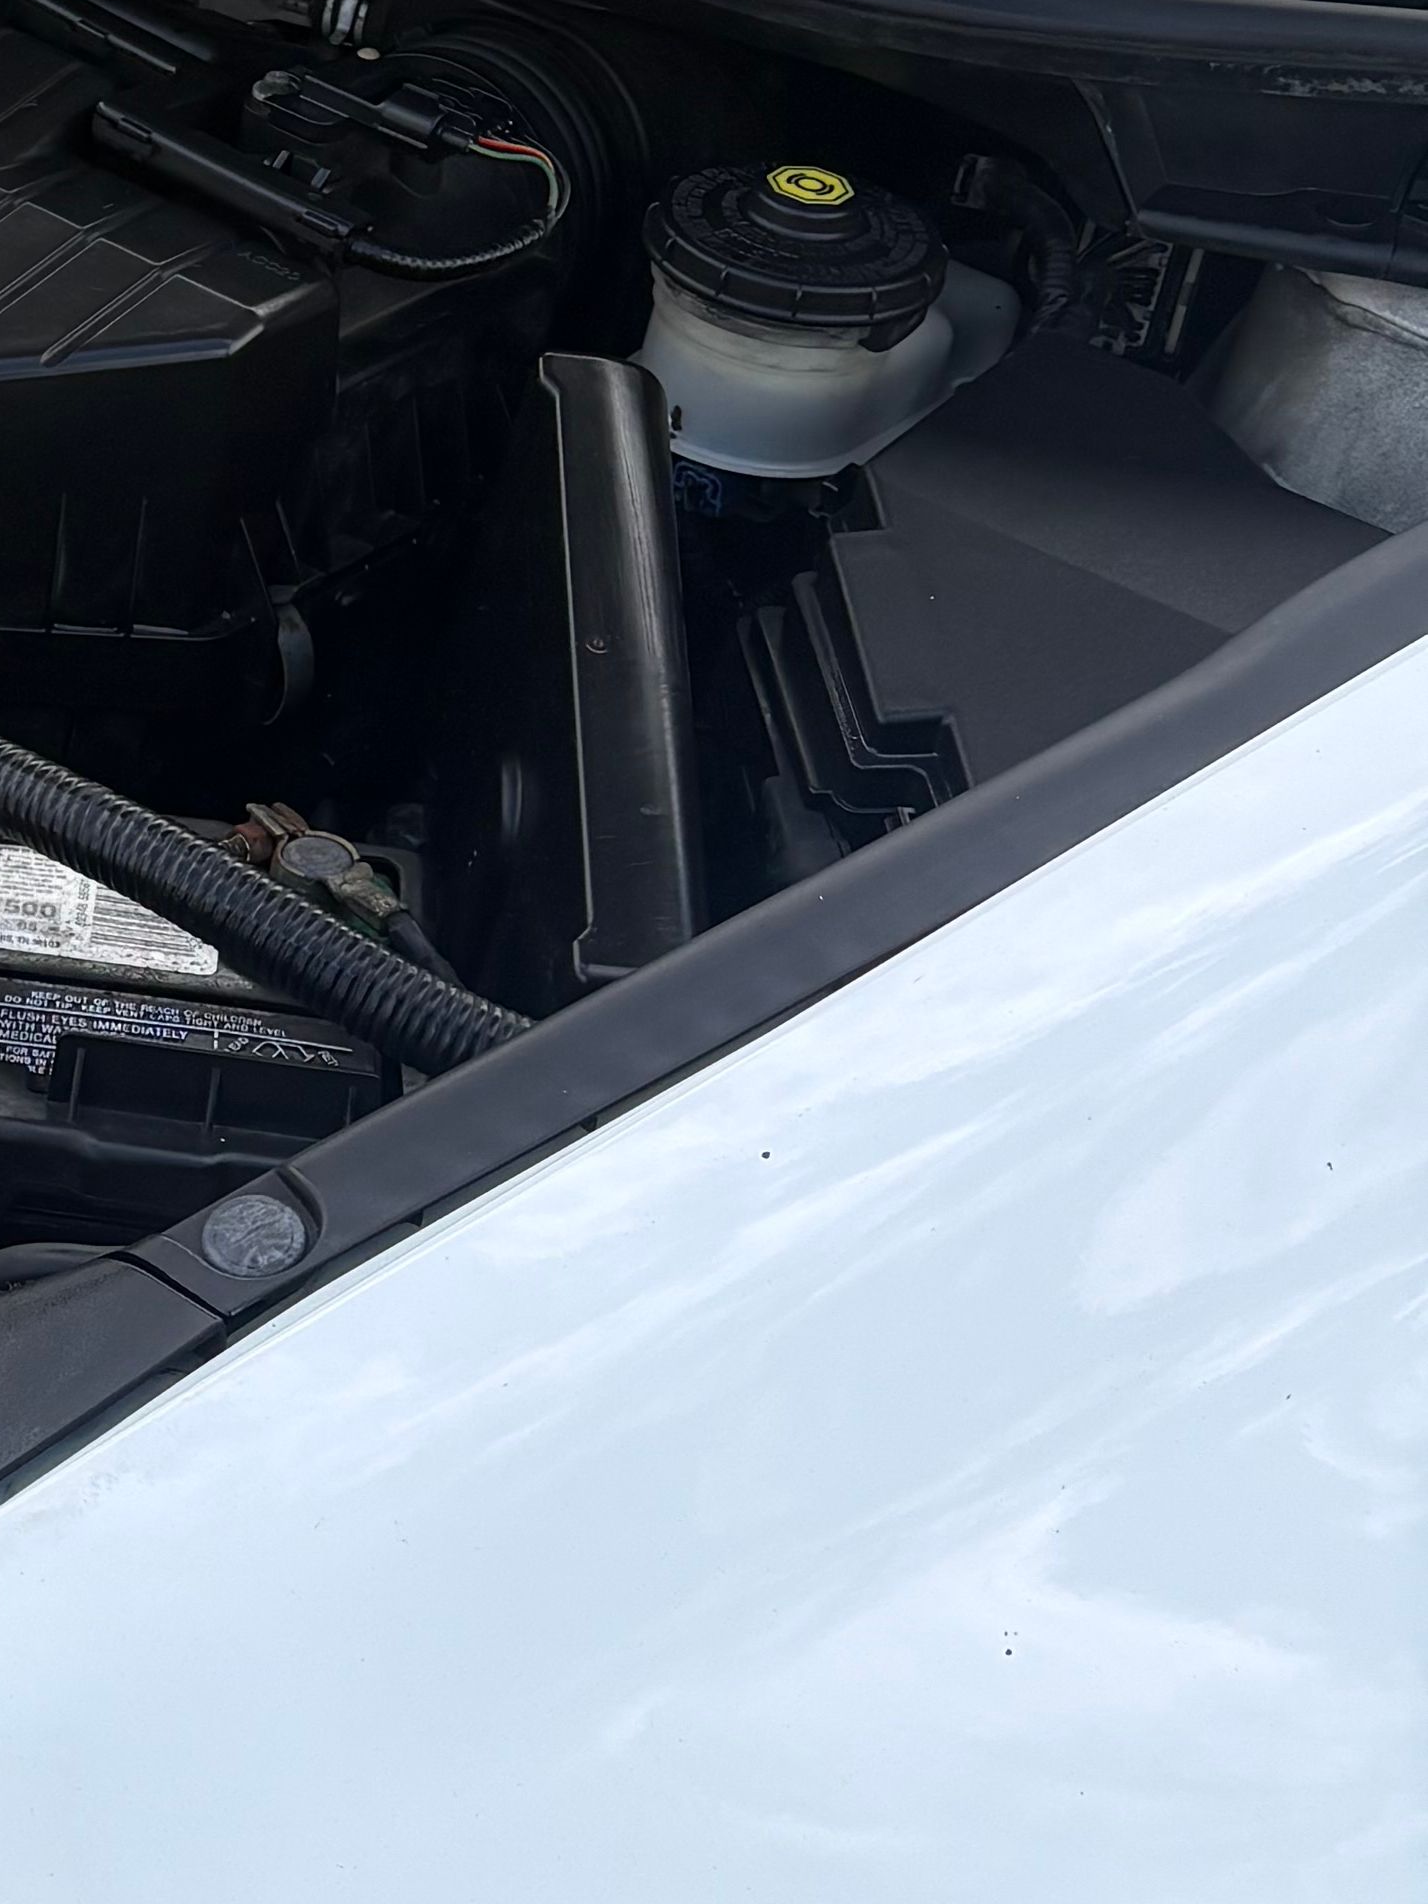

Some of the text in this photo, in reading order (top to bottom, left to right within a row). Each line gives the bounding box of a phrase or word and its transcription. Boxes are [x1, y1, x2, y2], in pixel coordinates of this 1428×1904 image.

[3, 899, 58, 918] 500
[4, 995, 22, 1004] DO
[25, 998, 48, 1007] NOT
[81, 1005, 111, 1014] KEEP
[115, 1007, 144, 1019] VENT
[185, 1017, 219, 1028] TIGHT
[224, 1022, 248, 1032] AND
[253, 1026, 286, 1038] LEVEL
[30, 991, 262, 1027] KEEP OUT OF THE REACH OF CHILDREN
[0, 1008, 46, 1022] FLUSH
[51, 1014, 87, 1028] EYES
[93, 1020, 188, 1040] IMMEDIATELY
[0, 1019, 36, 1032] WITH
[6, 1045, 29, 1055] FOR
